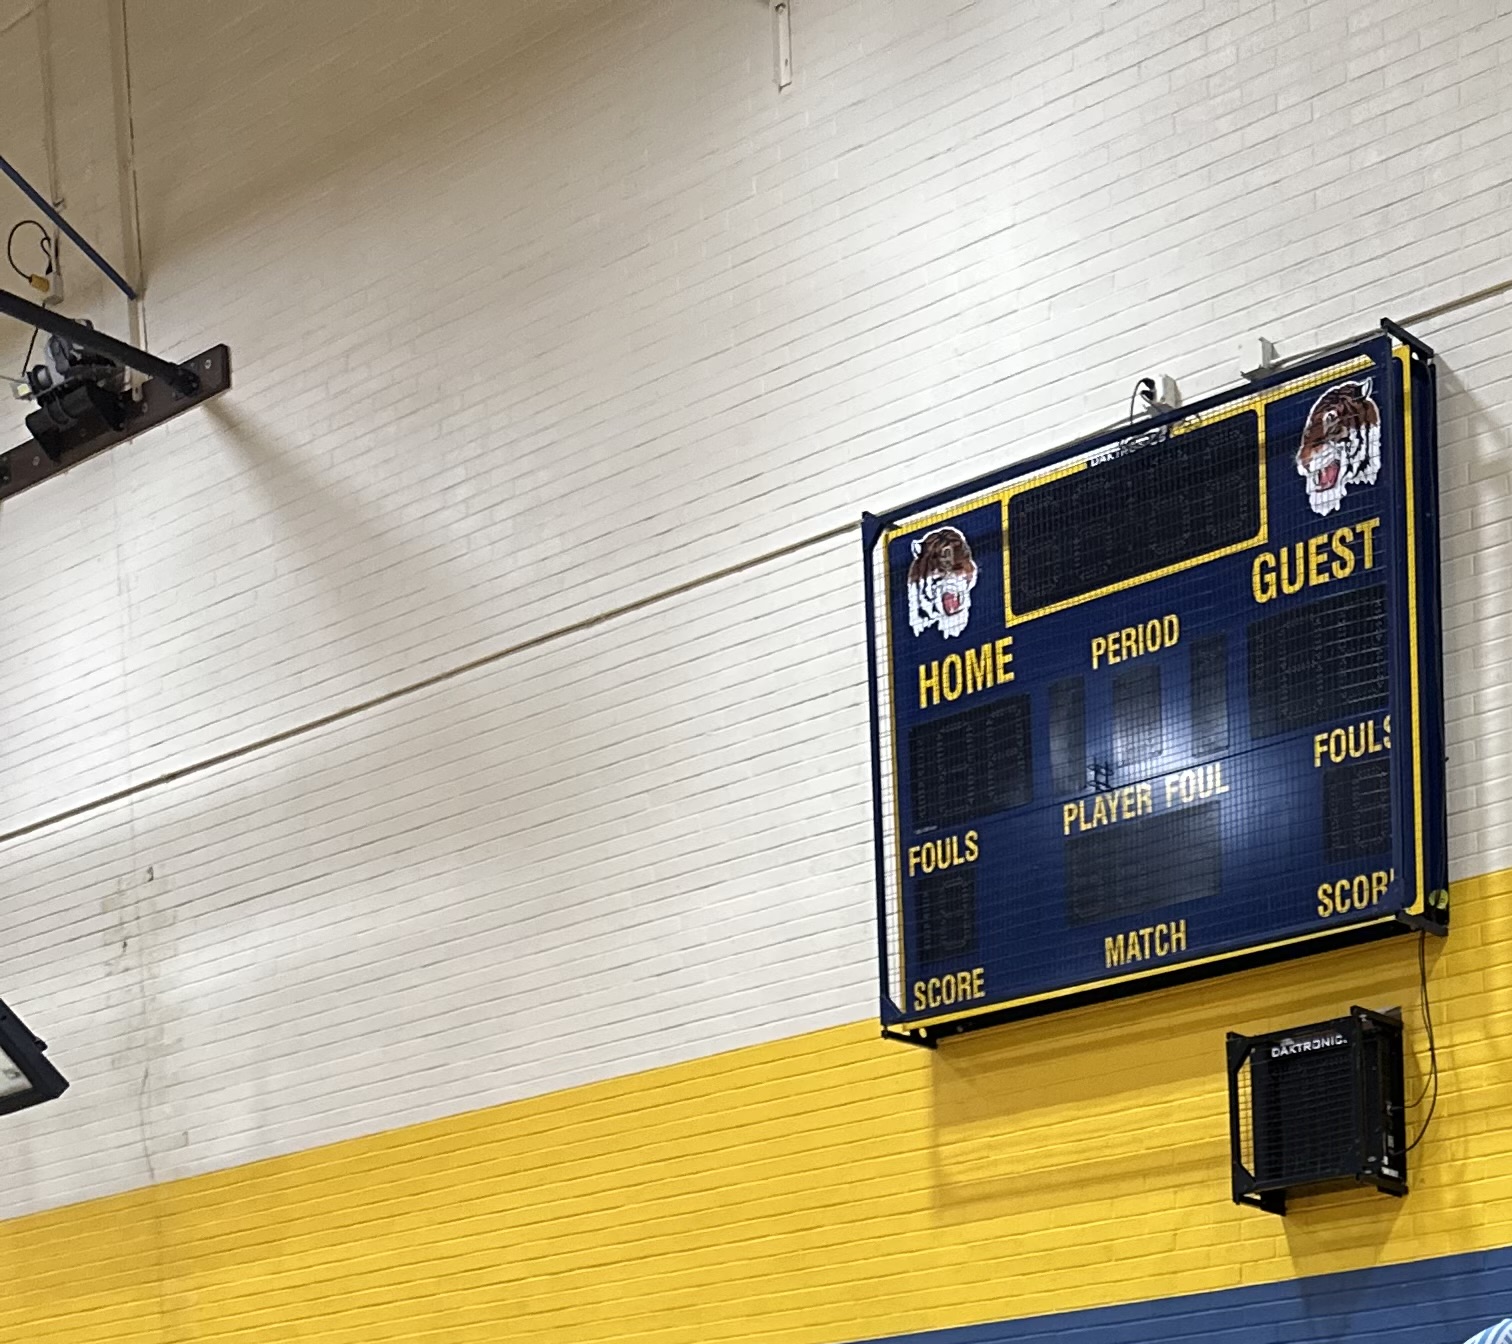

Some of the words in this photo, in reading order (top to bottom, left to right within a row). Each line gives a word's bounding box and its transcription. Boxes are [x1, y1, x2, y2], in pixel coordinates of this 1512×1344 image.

[1251, 516, 1381, 604] GUEST
[1091, 613, 1181, 670] PERIOD
[918, 635, 1016, 709] HOME
[1062, 781, 1153, 836] PLAYER
[1164, 761, 1230, 808] FOUL
[908, 829, 979, 877] FOULS
[1317, 867, 1395, 918] SCOR
[1104, 919, 1187, 969] MATCH
[913, 967, 986, 1022] SCORE
[1271, 1033, 1348, 1058] DAKTRONIC
